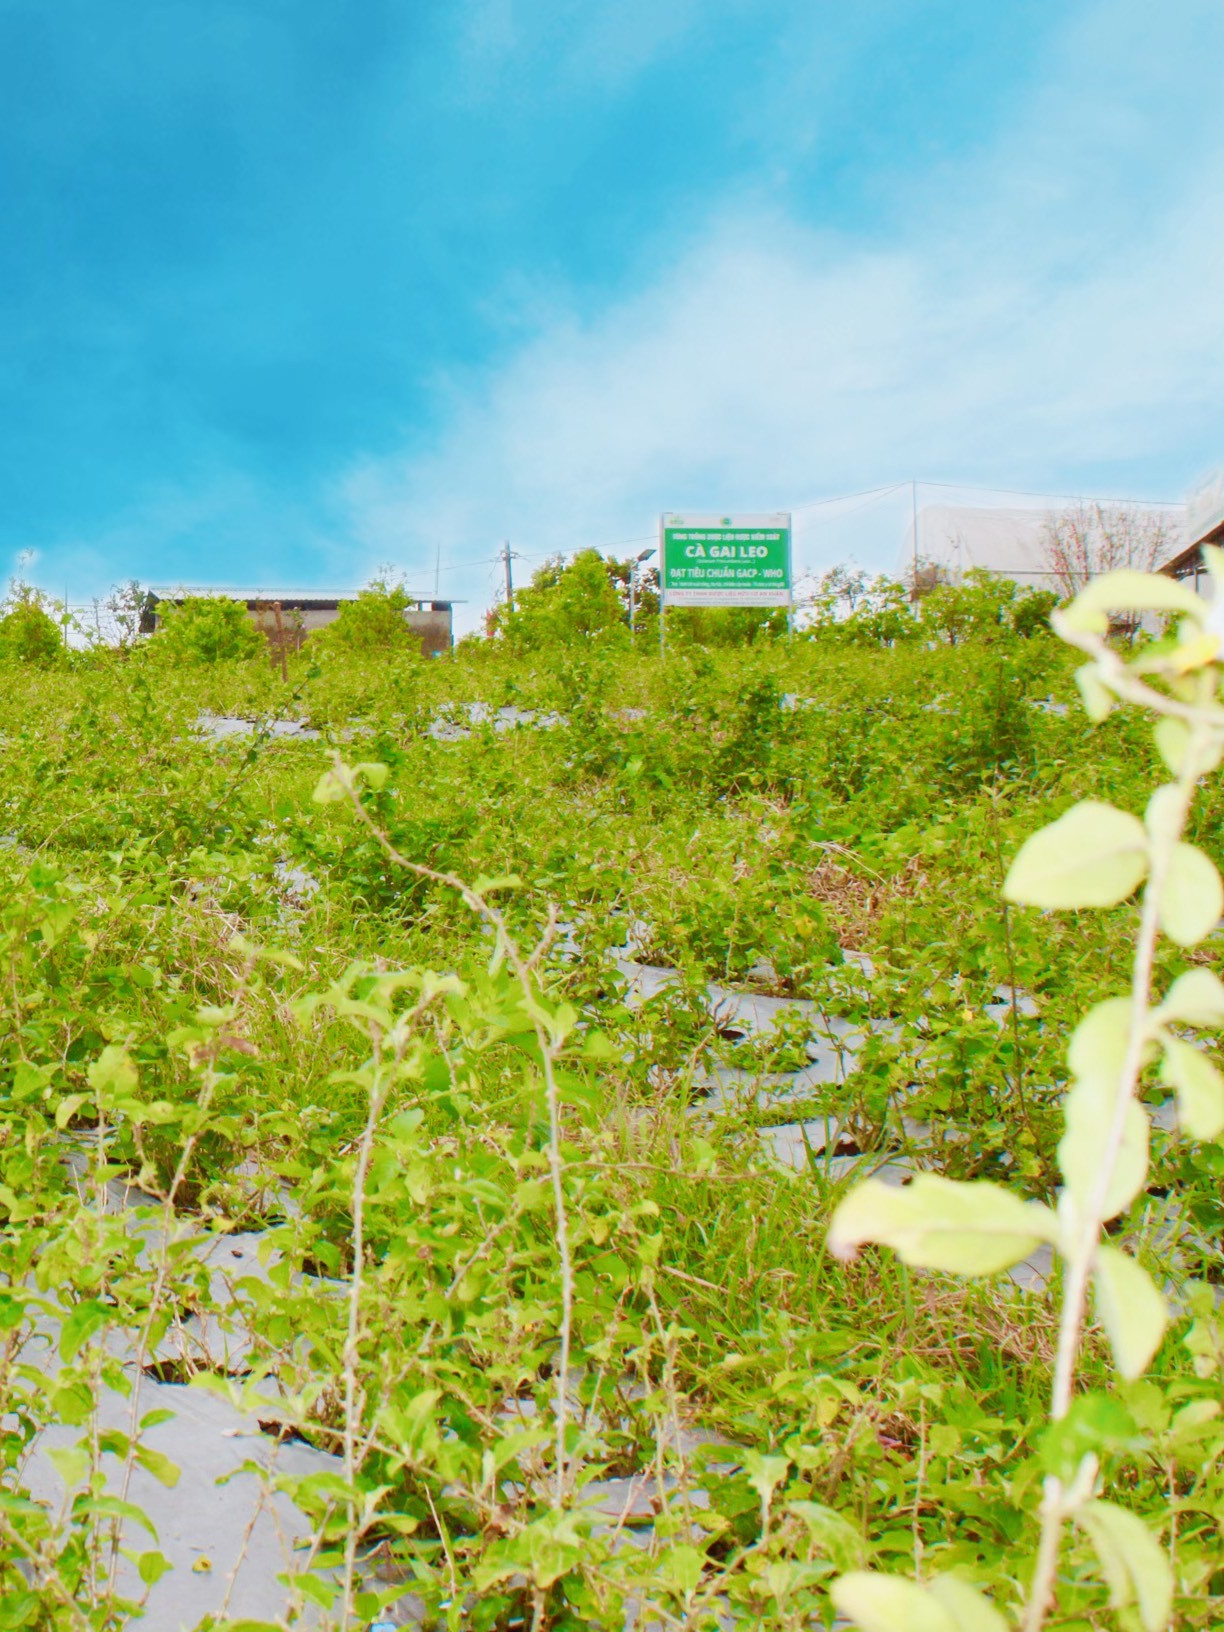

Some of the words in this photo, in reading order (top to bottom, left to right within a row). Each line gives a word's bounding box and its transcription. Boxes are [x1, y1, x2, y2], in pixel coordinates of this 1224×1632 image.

[686, 542, 706, 557] CÀ
[710, 546, 736, 557] GAI
[740, 546, 768, 557] LEO
[670, 568, 686, 580] ĐẠT
[688, 566, 705, 578] TIÊU
[736, 568, 758, 578] GACP
[762, 568, 784, 578] WHO
